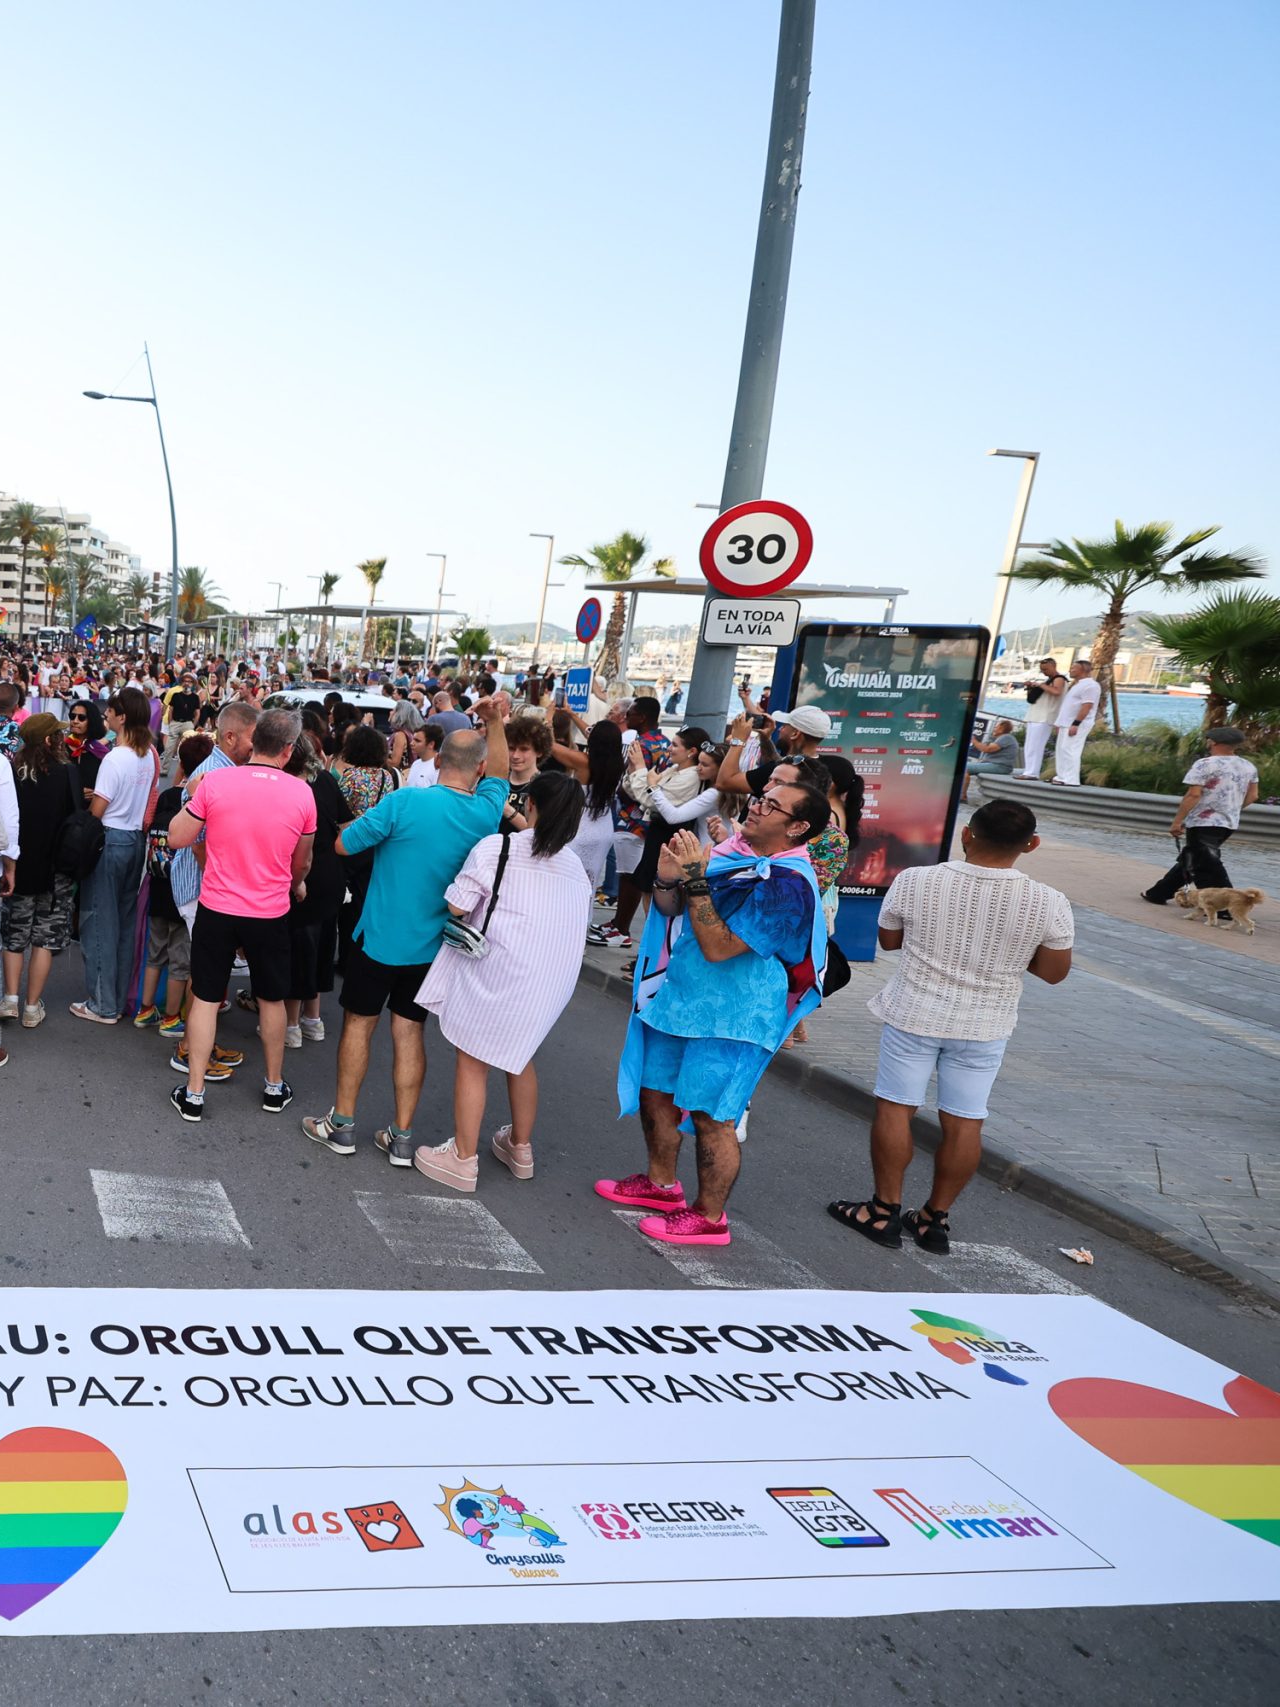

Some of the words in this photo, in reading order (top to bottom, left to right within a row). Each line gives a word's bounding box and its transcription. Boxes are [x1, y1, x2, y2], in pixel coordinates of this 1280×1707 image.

[726, 533, 787, 565] 30
[717, 609, 739, 621] EN
[742, 610, 785, 622] TODA
[724, 623, 744, 634] LA
[747, 621, 773, 635] VÍA
[828, 671, 892, 689] USHUAÏA
[896, 674, 937, 690] IBIZA
[567, 682, 589, 697] TAXI
[901, 765, 925, 775] ANTS
[89, 1324, 345, 1356] ORGULL
[353, 1325, 493, 1356] QUE
[490, 1324, 913, 1356] TRANSFORMA
[955, 1336, 1038, 1353] Ibiza
[46, 1376, 168, 1407] PAZ:
[184, 1375, 454, 1408] ORGULLO
[466, 1375, 595, 1405] QUE
[586, 1371, 972, 1404] TRANSFORMA
[623, 1501, 746, 1523] FELGTBI+
[785, 1500, 847, 1512] IBIZA
[929, 1503, 951, 1516] sa
[951, 1500, 989, 1515] clau
[988, 1499, 1010, 1513] de
[243, 1504, 344, 1535] alas
[799, 1514, 867, 1533] LGTB
[485, 1552, 566, 1566] Chrysallis
[509, 1567, 559, 1578] Baleares
